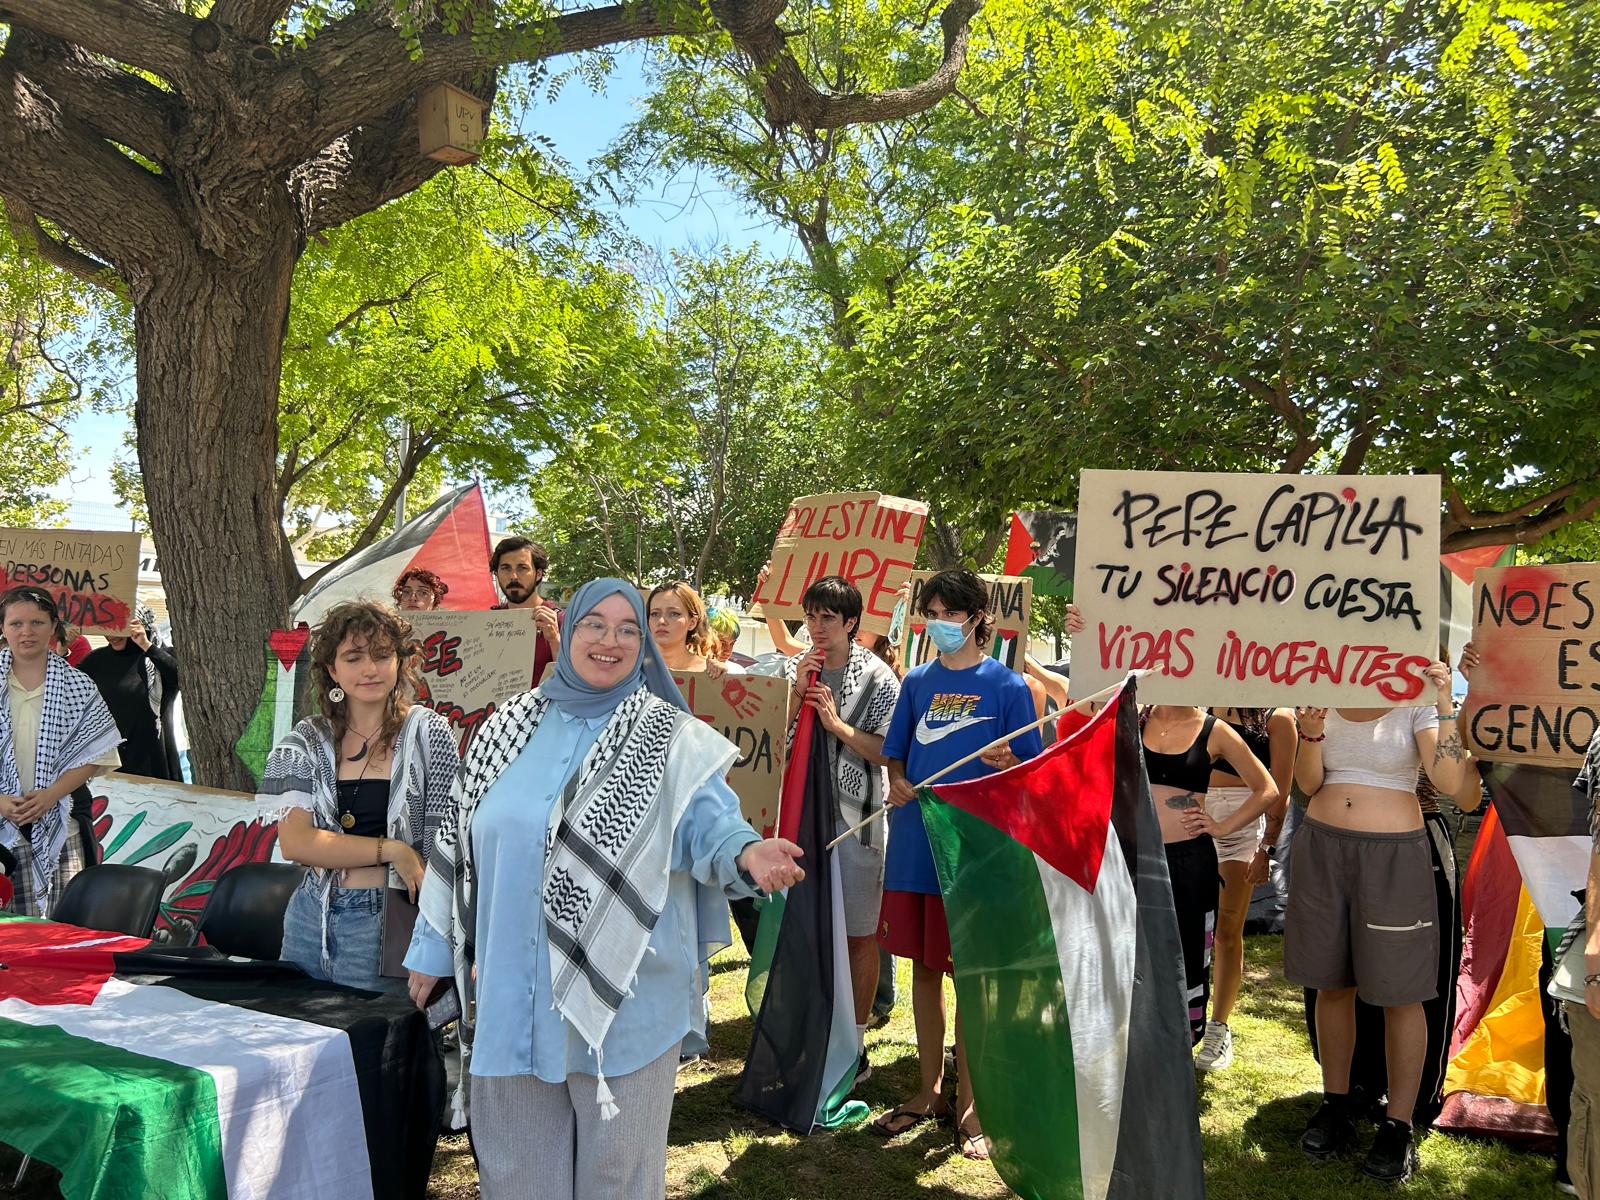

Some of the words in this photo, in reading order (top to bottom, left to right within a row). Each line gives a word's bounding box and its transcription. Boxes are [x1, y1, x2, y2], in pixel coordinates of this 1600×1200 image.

[776, 500, 928, 547] PALESTINA
[1113, 489, 1249, 549] PEPE
[1255, 484, 1424, 560] CAPILLA
[5, 560, 110, 592] PERSONAS
[20, 538, 46, 559] MÁS
[53, 540, 124, 571] PINTADAS
[1095, 563, 1143, 599] TU
[1304, 573, 1422, 630] CUESTA
[1471, 704, 1599, 754] GENO
